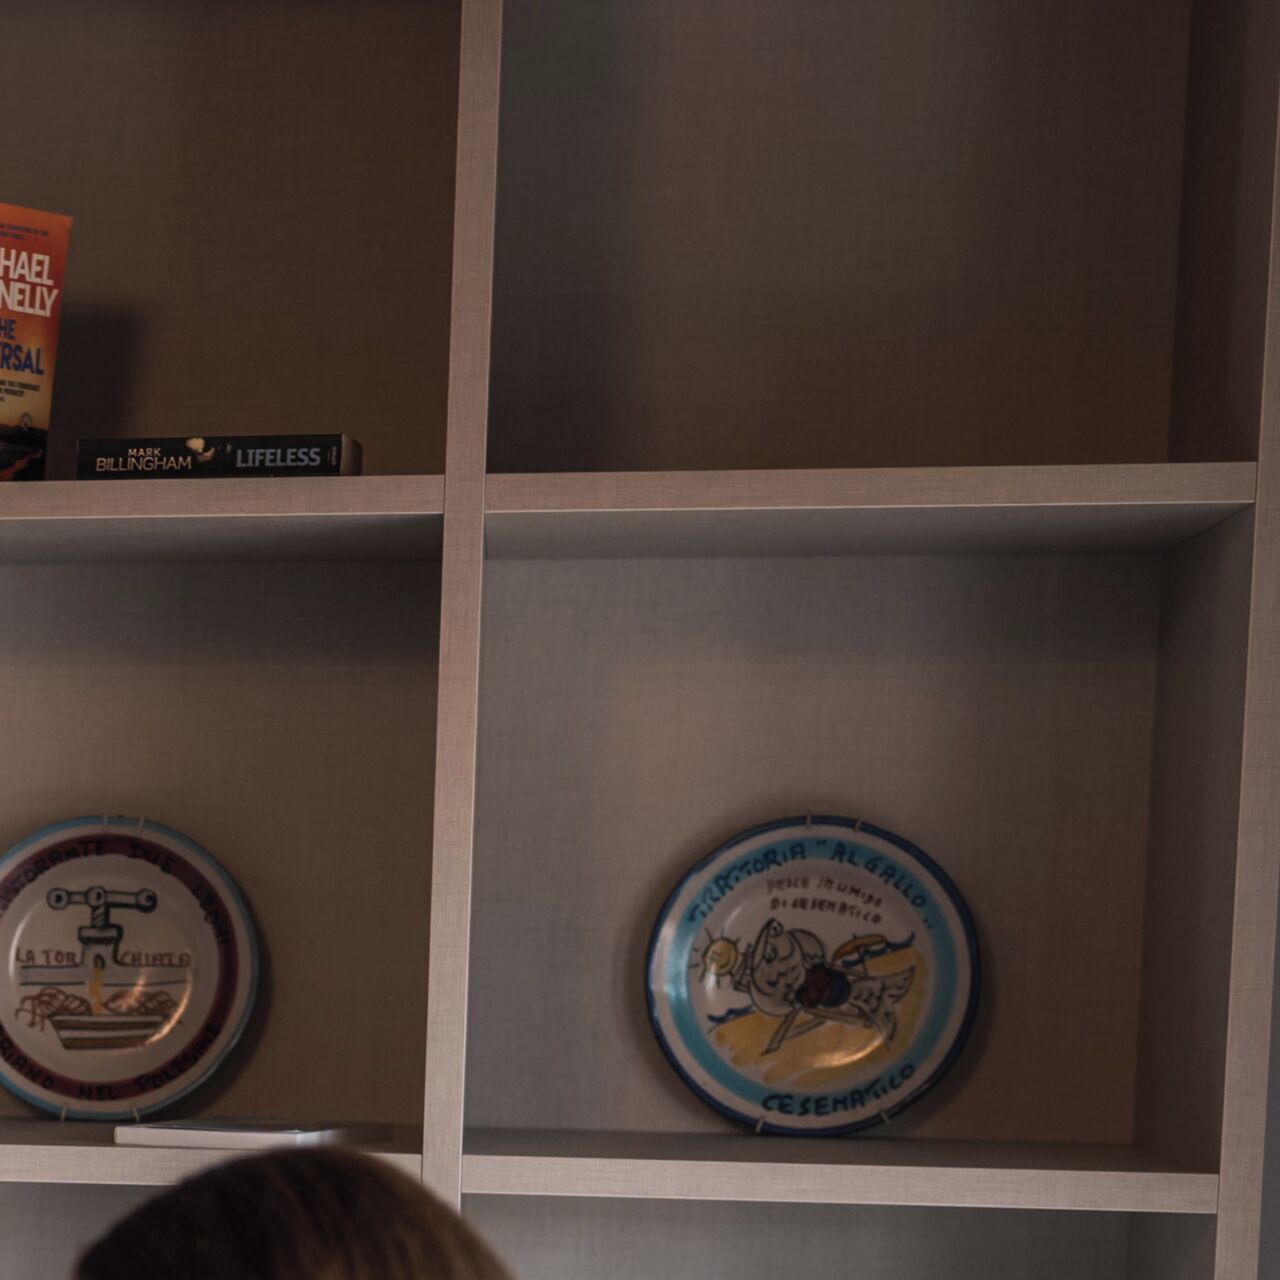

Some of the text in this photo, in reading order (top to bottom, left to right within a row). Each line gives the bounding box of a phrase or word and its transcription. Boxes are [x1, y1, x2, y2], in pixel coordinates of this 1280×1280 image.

[127, 447, 162, 458] MARK
[236, 447, 322, 468] LIFELESS
[95, 456, 193, 473] BILLINGHAM
[126, 843, 175, 875] DUE
[688, 842, 807, 923] TRATTORIA
[42, 949, 78, 966] TOR
[77, 1085, 120, 1101] NEL
